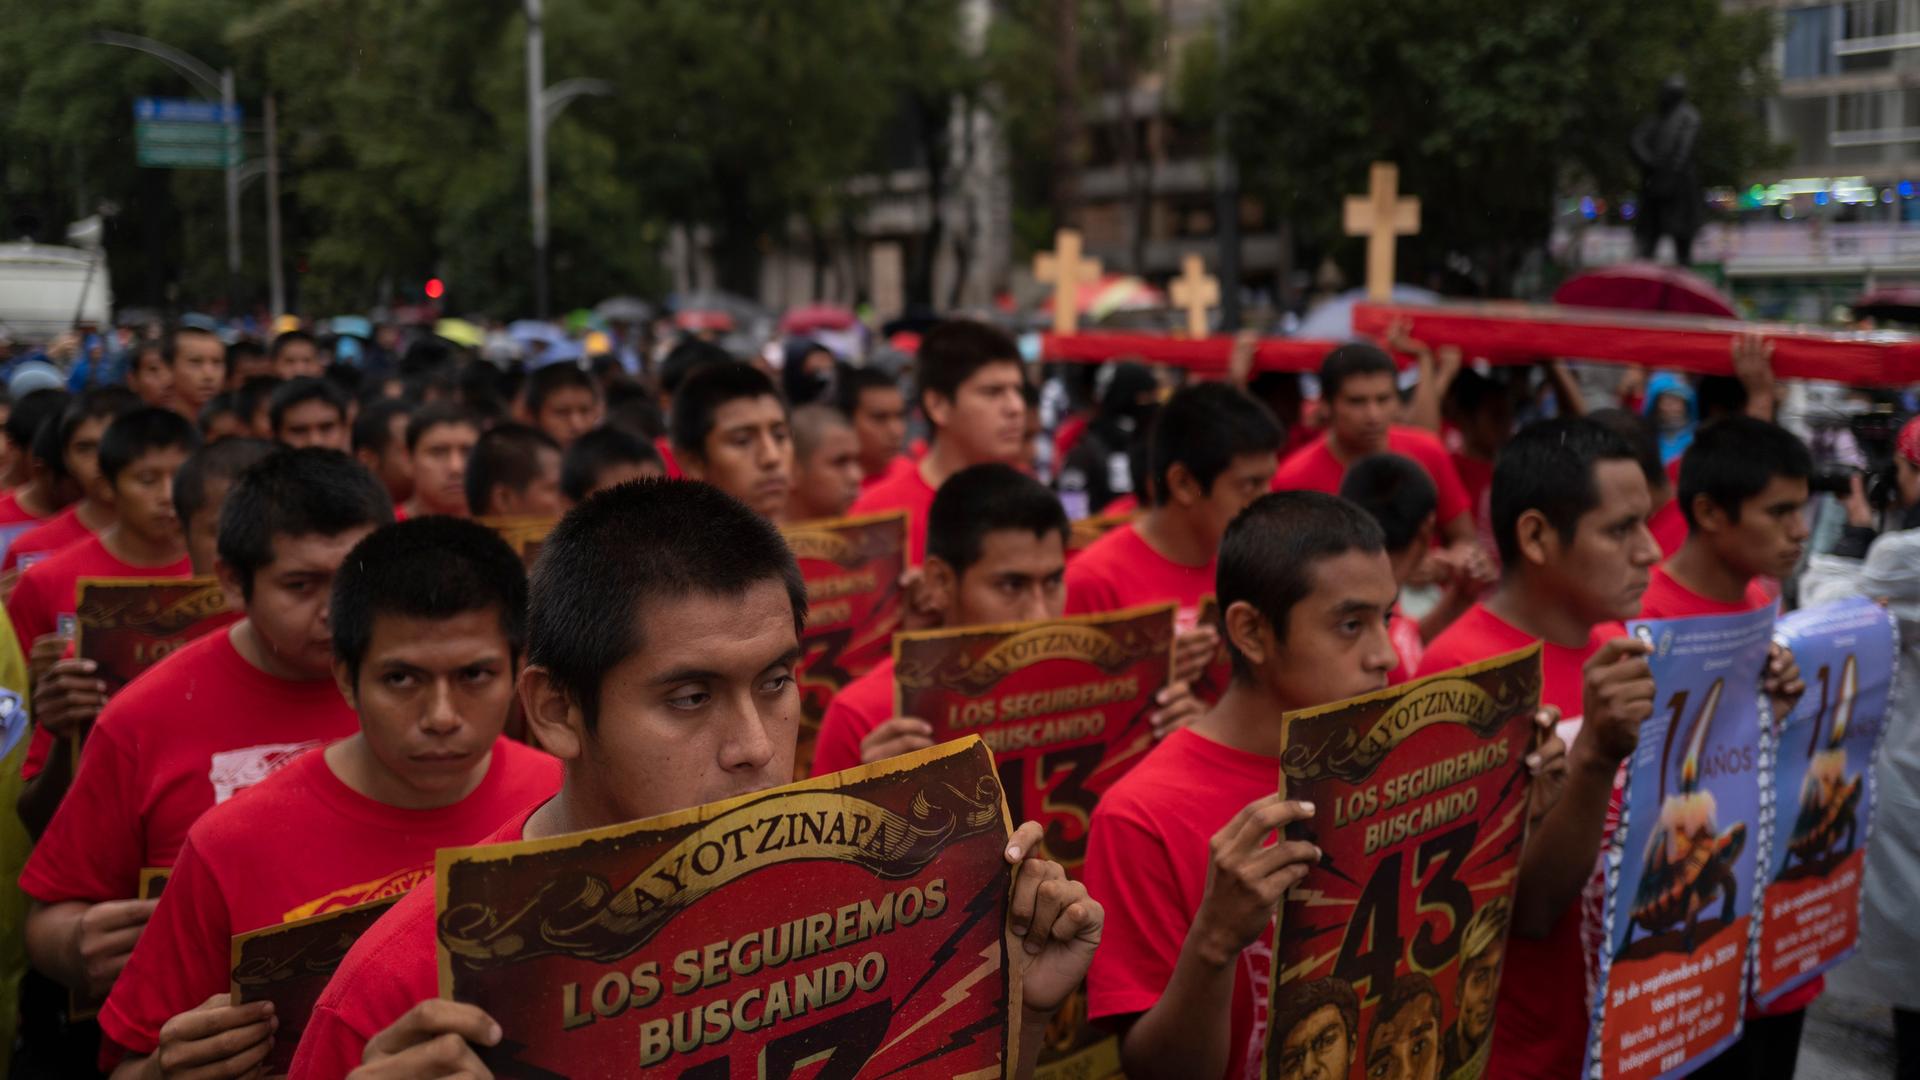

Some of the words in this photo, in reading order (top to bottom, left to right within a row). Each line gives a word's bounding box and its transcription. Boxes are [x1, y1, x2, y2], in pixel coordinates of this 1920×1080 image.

[981, 631, 1113, 677] AYOTZINAPA
[949, 702, 996, 730] LOS
[1001, 678, 1139, 720] SEGUIREMOS
[1369, 692, 1487, 758] AYOTZINAPA
[1334, 787, 1379, 828] LOS
[1383, 738, 1509, 810] SEGUIREMOS
[1703, 744, 1754, 778] AÑOS
[1365, 787, 1479, 856] BUSCANDO
[633, 811, 887, 919] AYOTZINAPA
[1331, 821, 1479, 1008] 43
[562, 962, 663, 1030] LOS
[672, 878, 948, 995] SEGUIREMOS
[1627, 982, 1640, 1000] de
[1642, 962, 1700, 994] septiembre
[1701, 954, 1714, 972] de
[639, 952, 888, 1068] BUSCANDO
